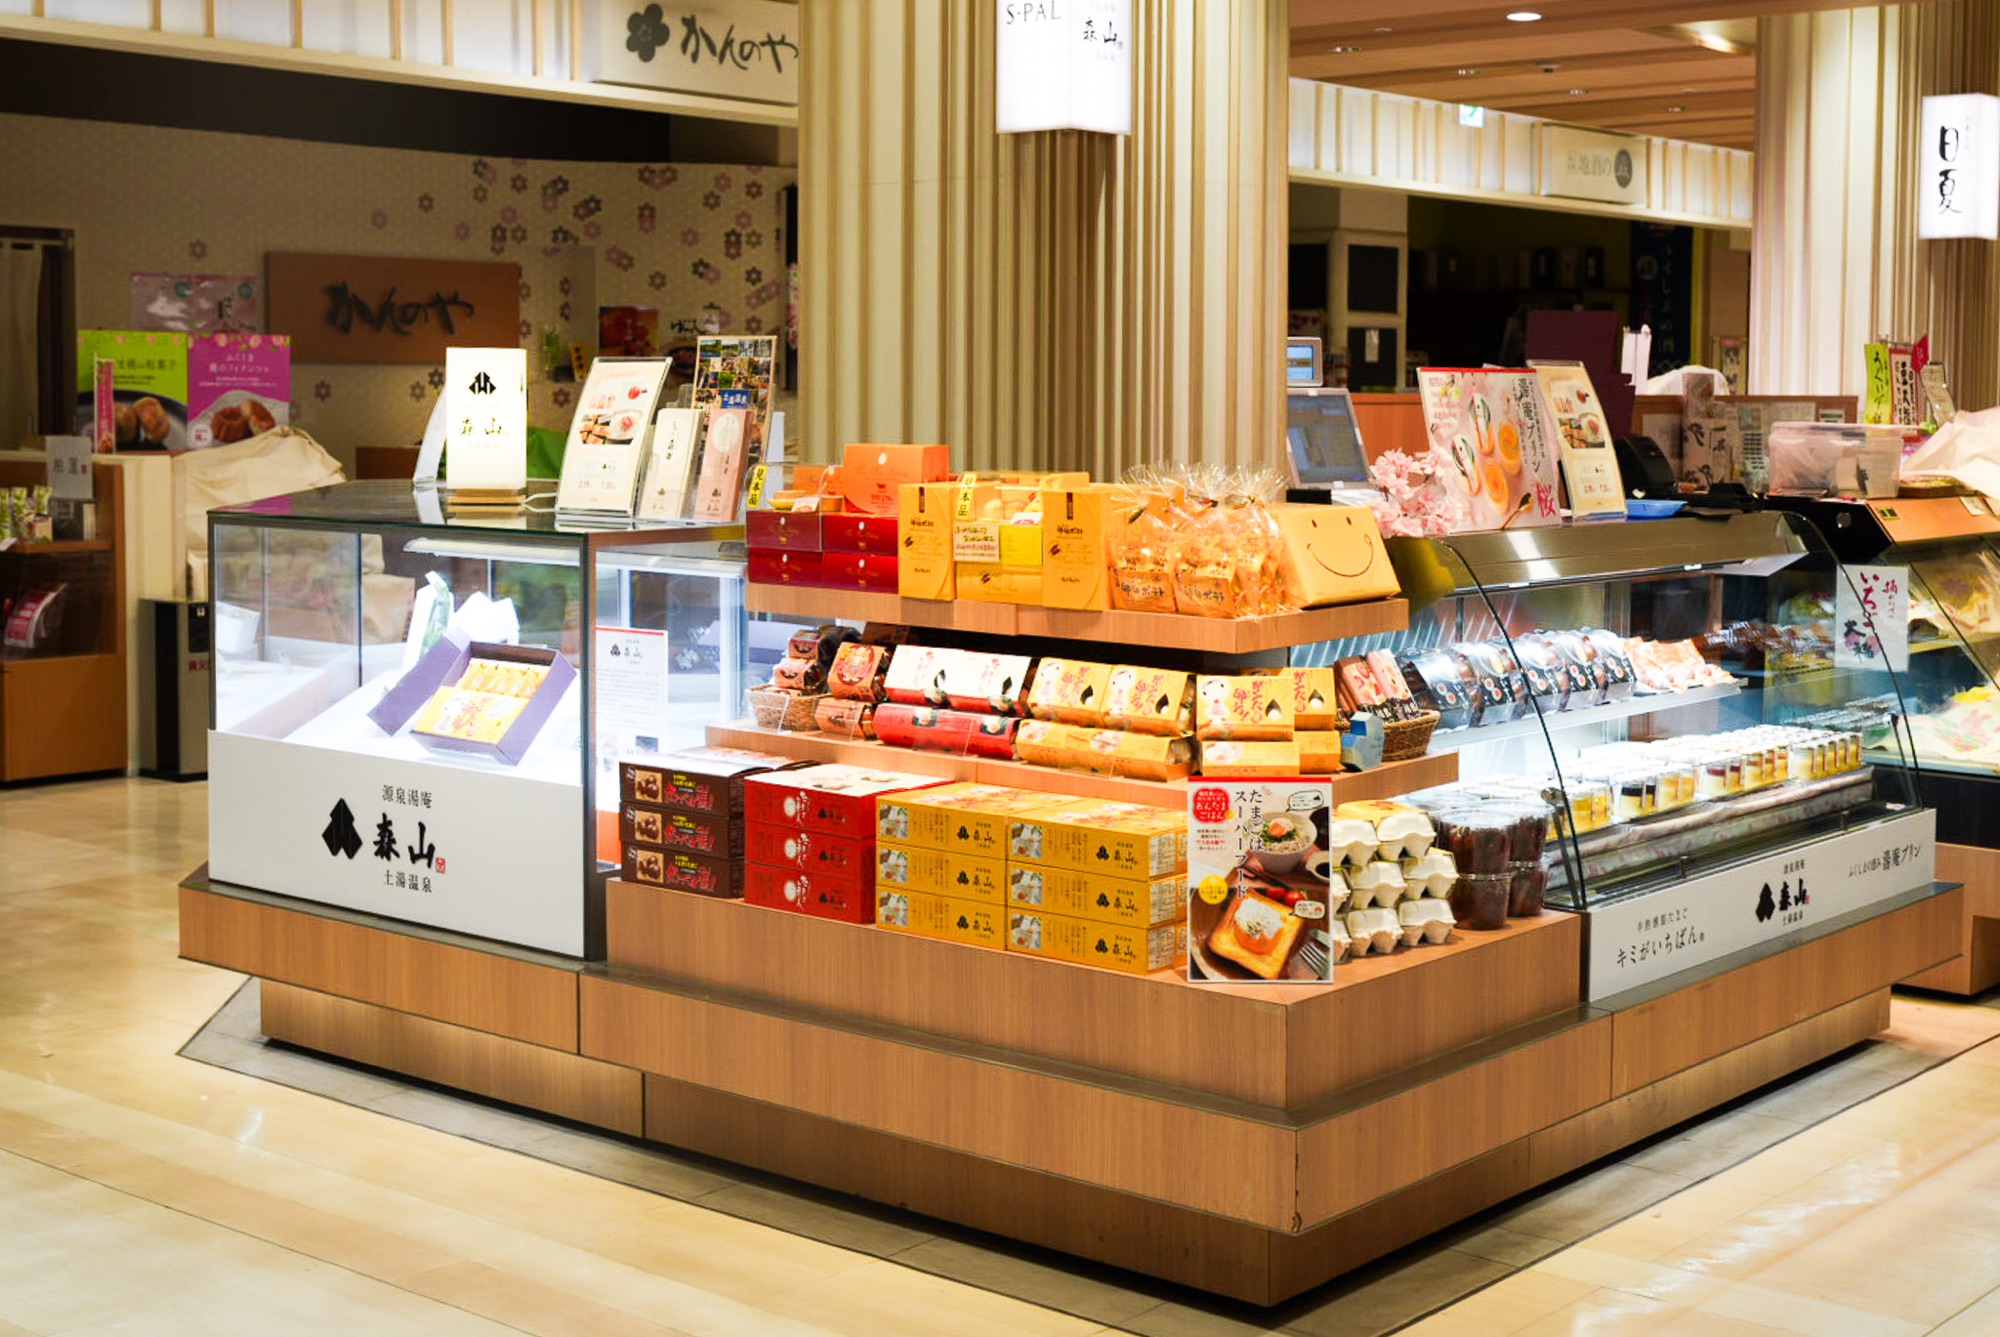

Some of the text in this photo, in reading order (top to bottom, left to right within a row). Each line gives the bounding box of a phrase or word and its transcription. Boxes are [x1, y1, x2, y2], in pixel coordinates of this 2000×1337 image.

[1006, 1, 1062, 25] S-PAL
[1083, 17, 1118, 44] 森山
[681, 14, 799, 73] かんのや
[1938, 125, 1963, 214] 日夏
[324, 280, 475, 335] かんのや
[460, 416, 502, 436] 森山
[748, 466, 765, 506] 見本品
[957, 476, 974, 517] 見本品
[1536, 481, 1556, 518] 桜
[382, 784, 433, 809] 源泉湯庵
[373, 812, 436, 868] 森山
[383, 869, 433, 893] 土湯温泉
[1616, 925, 1705, 969] キミがいちばん。
